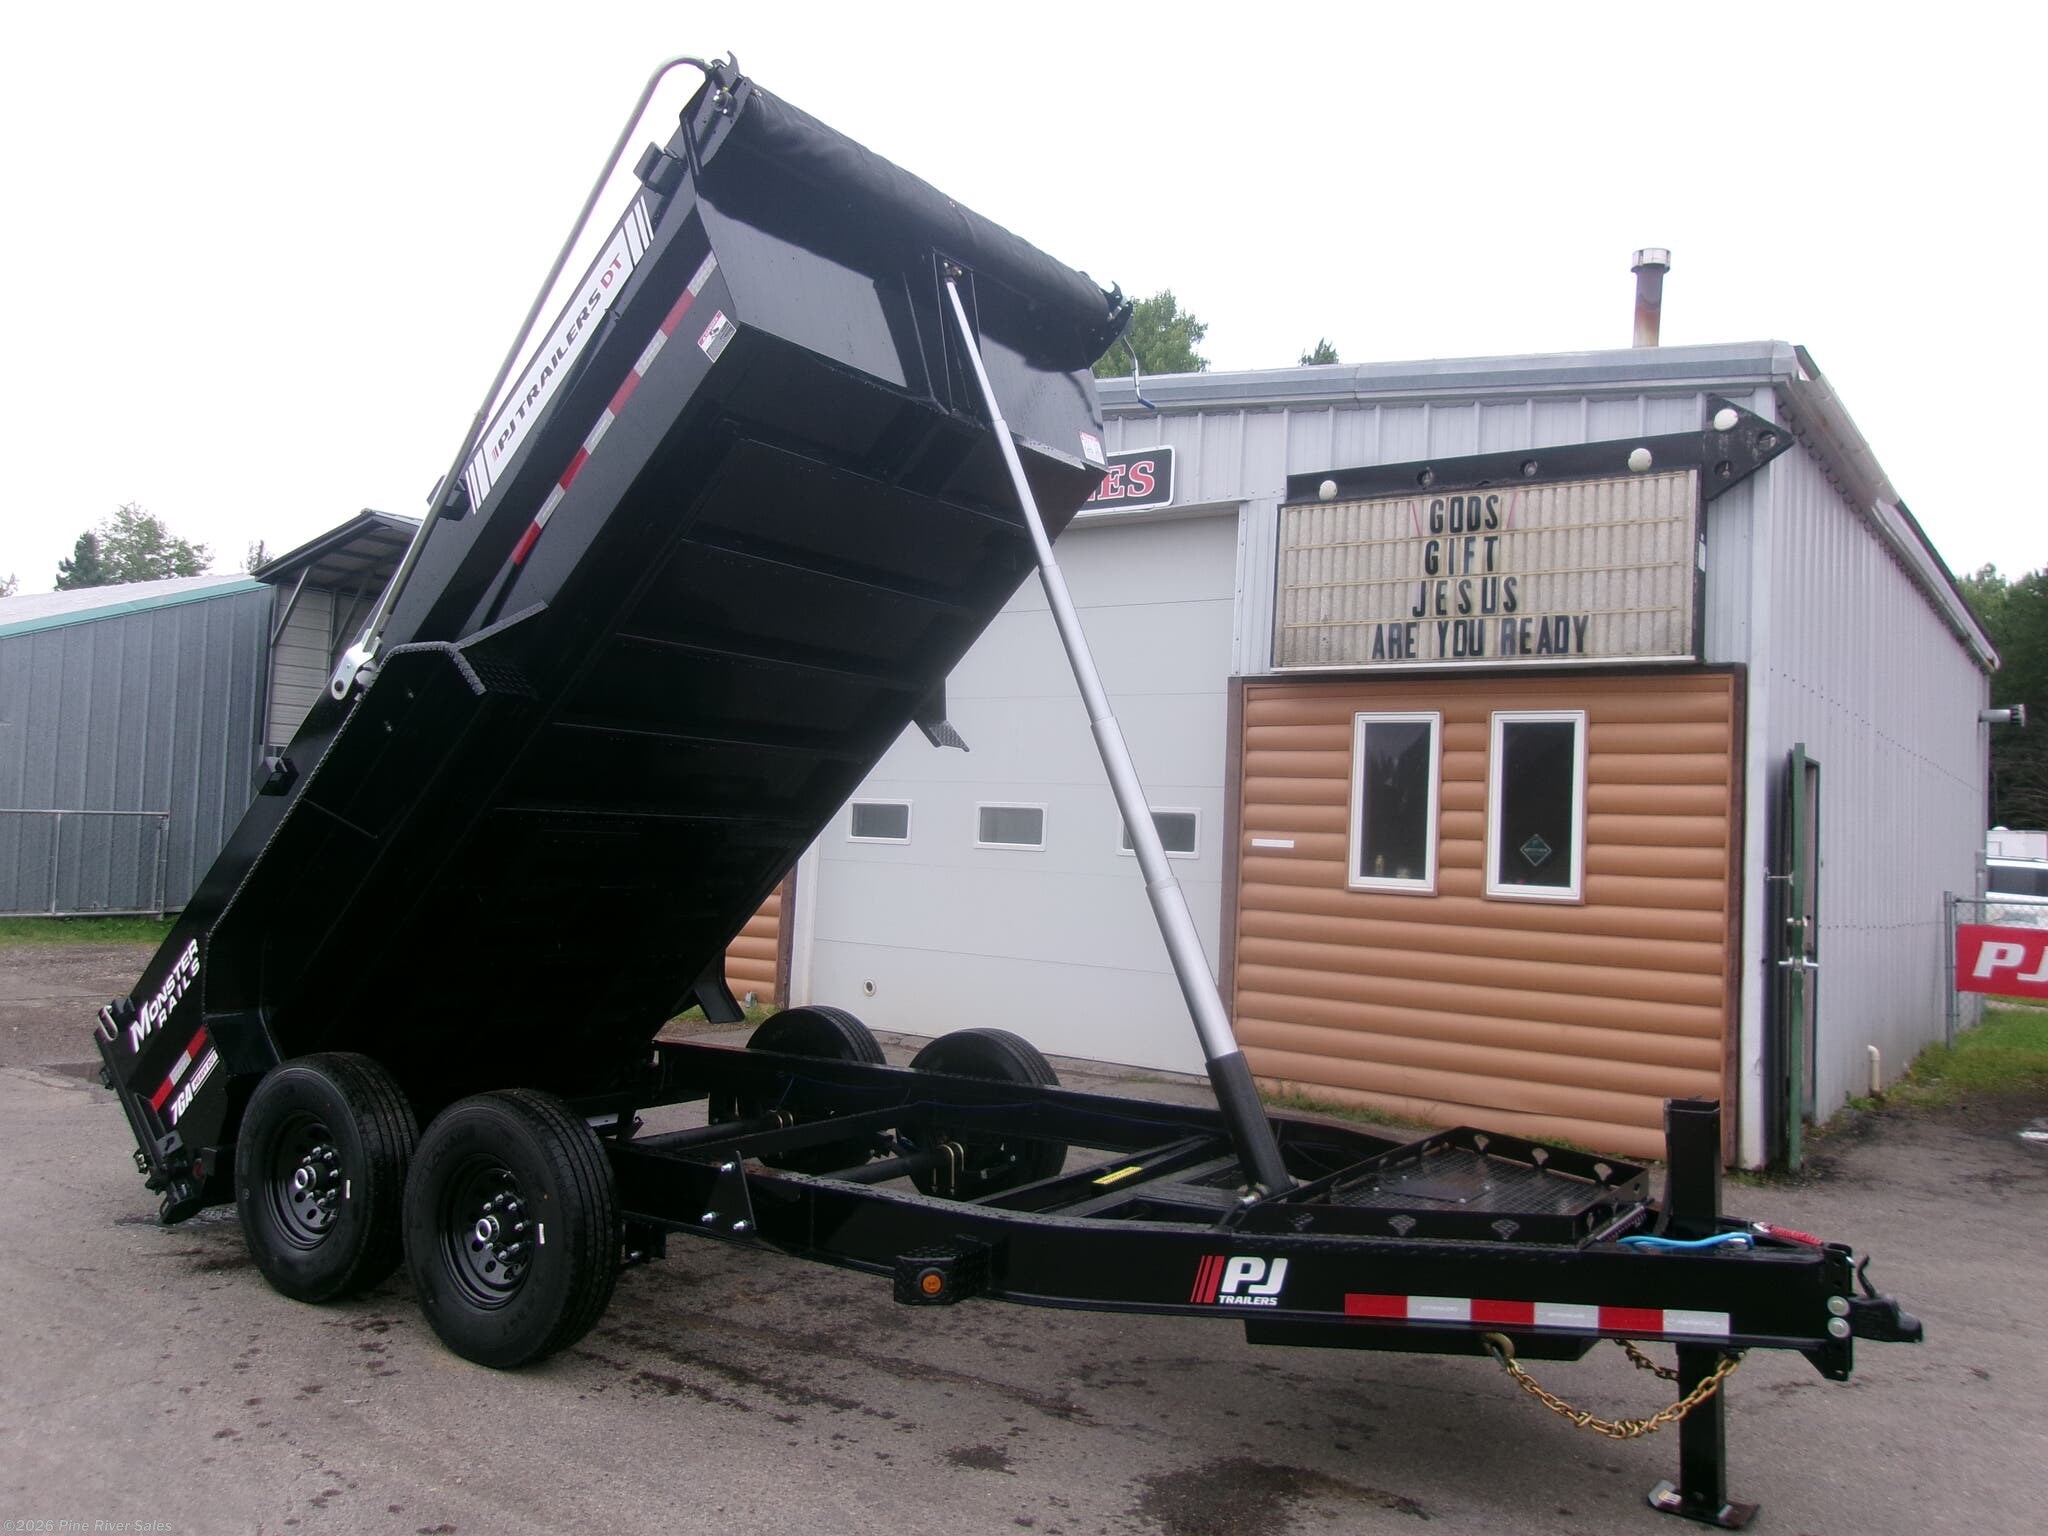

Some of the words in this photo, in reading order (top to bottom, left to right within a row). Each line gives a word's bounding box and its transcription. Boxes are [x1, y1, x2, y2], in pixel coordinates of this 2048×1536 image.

[496, 419, 516, 453] PJ
[513, 287, 602, 421] TRAILERS
[600, 252, 623, 290] DT
[1087, 461, 1155, 501] ES
[1429, 494, 1499, 534] GODS
[1424, 536, 1499, 576] GIFT
[1412, 576, 1518, 618] JESUS
[1371, 621, 1418, 660] ARE
[1437, 619, 1484, 658] YOU
[1500, 615, 1589, 656] READY
[1972, 941, 2048, 982] PJ
[129, 938, 199, 1053] MONSTER
[158, 956, 201, 1028] RAILS
[170, 1082, 194, 1126] 7GA
[1221, 1256, 1289, 1295] PJ
[1219, 1294, 1278, 1306] TRAILERS
